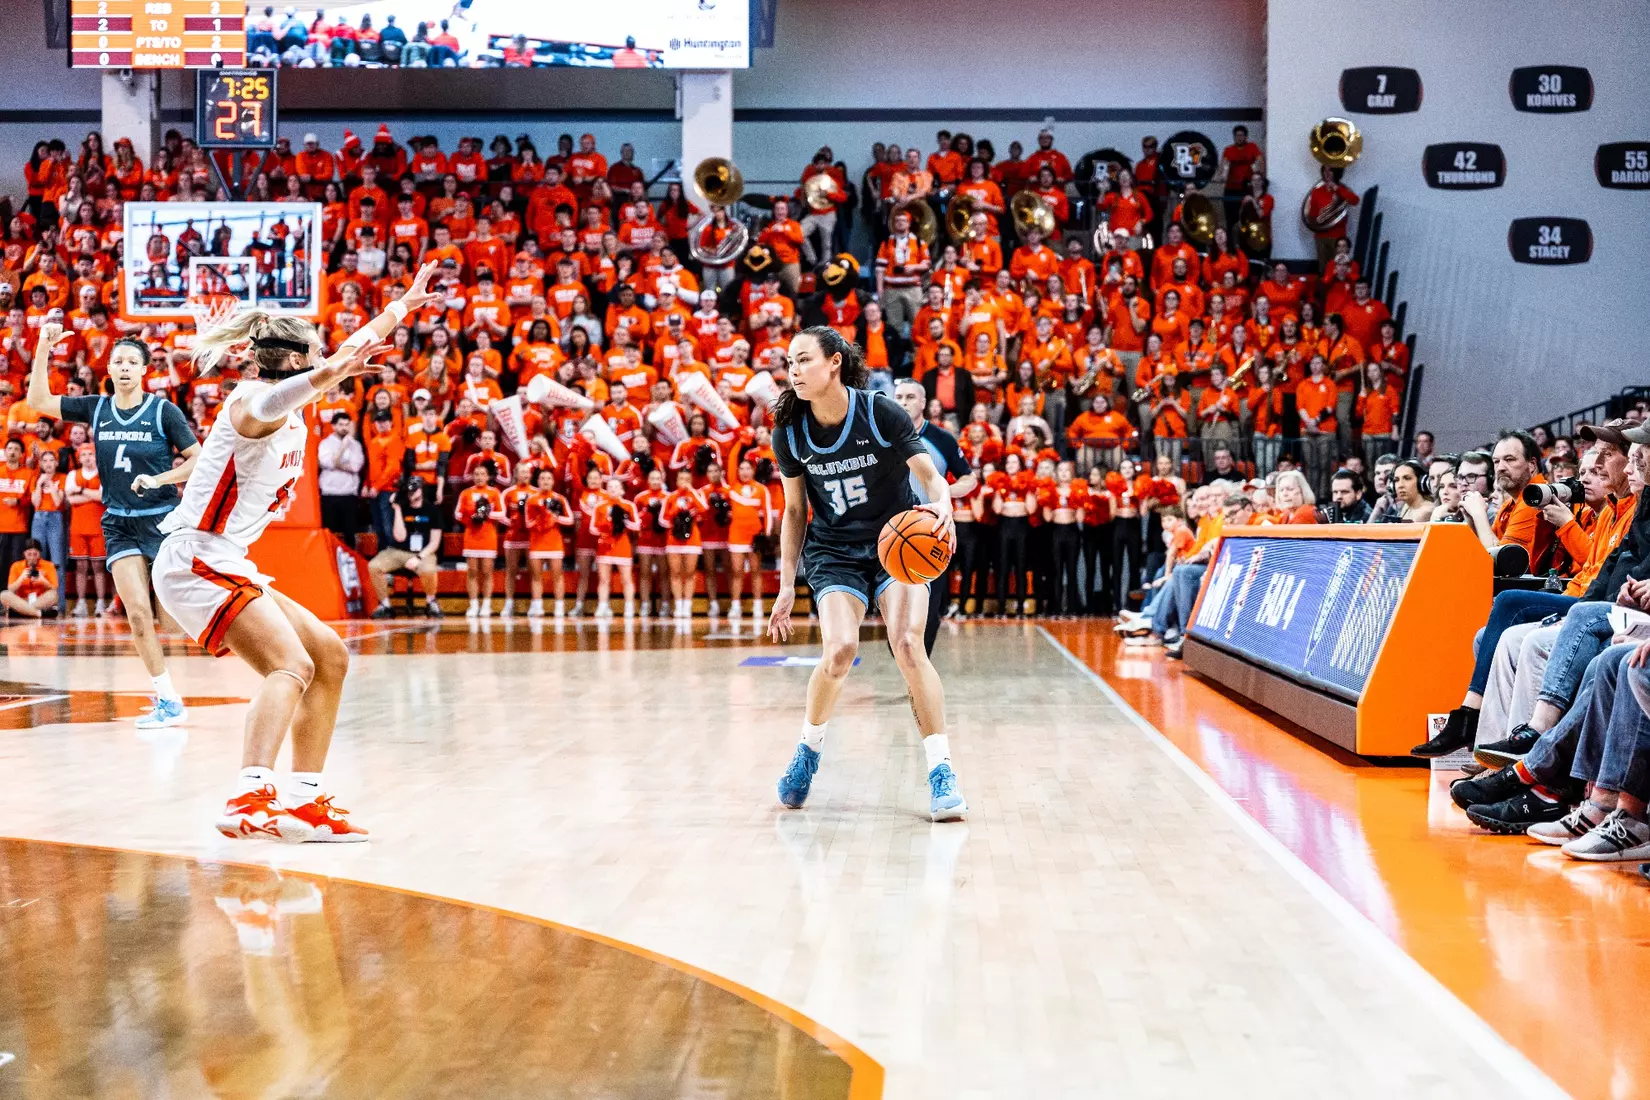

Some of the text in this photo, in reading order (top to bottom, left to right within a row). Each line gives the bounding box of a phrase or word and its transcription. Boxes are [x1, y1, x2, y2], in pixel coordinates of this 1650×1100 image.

[98, 18, 221, 32] 2 TO 1
[98, 35, 108, 48] 0
[99, 52, 109, 65] 0
[222, 77, 269, 99] 7:25
[1376, 74, 1387, 93] 7
[1538, 74, 1562, 93] 30
[1367, 94, 1397, 108] GRAY
[1526, 93, 1577, 107] KOMIVES
[214, 101, 262, 139] 27
[1453, 150, 1477, 170] 42
[1624, 150, 1648, 169] 55
[1611, 170, 1650, 183] DARRO
[1538, 225, 1562, 245] 34
[1529, 245, 1571, 259] STACEY
[98, 431, 153, 442] COLUMBIA
[113, 444, 132, 473] 4
[823, 474, 869, 517] 35
